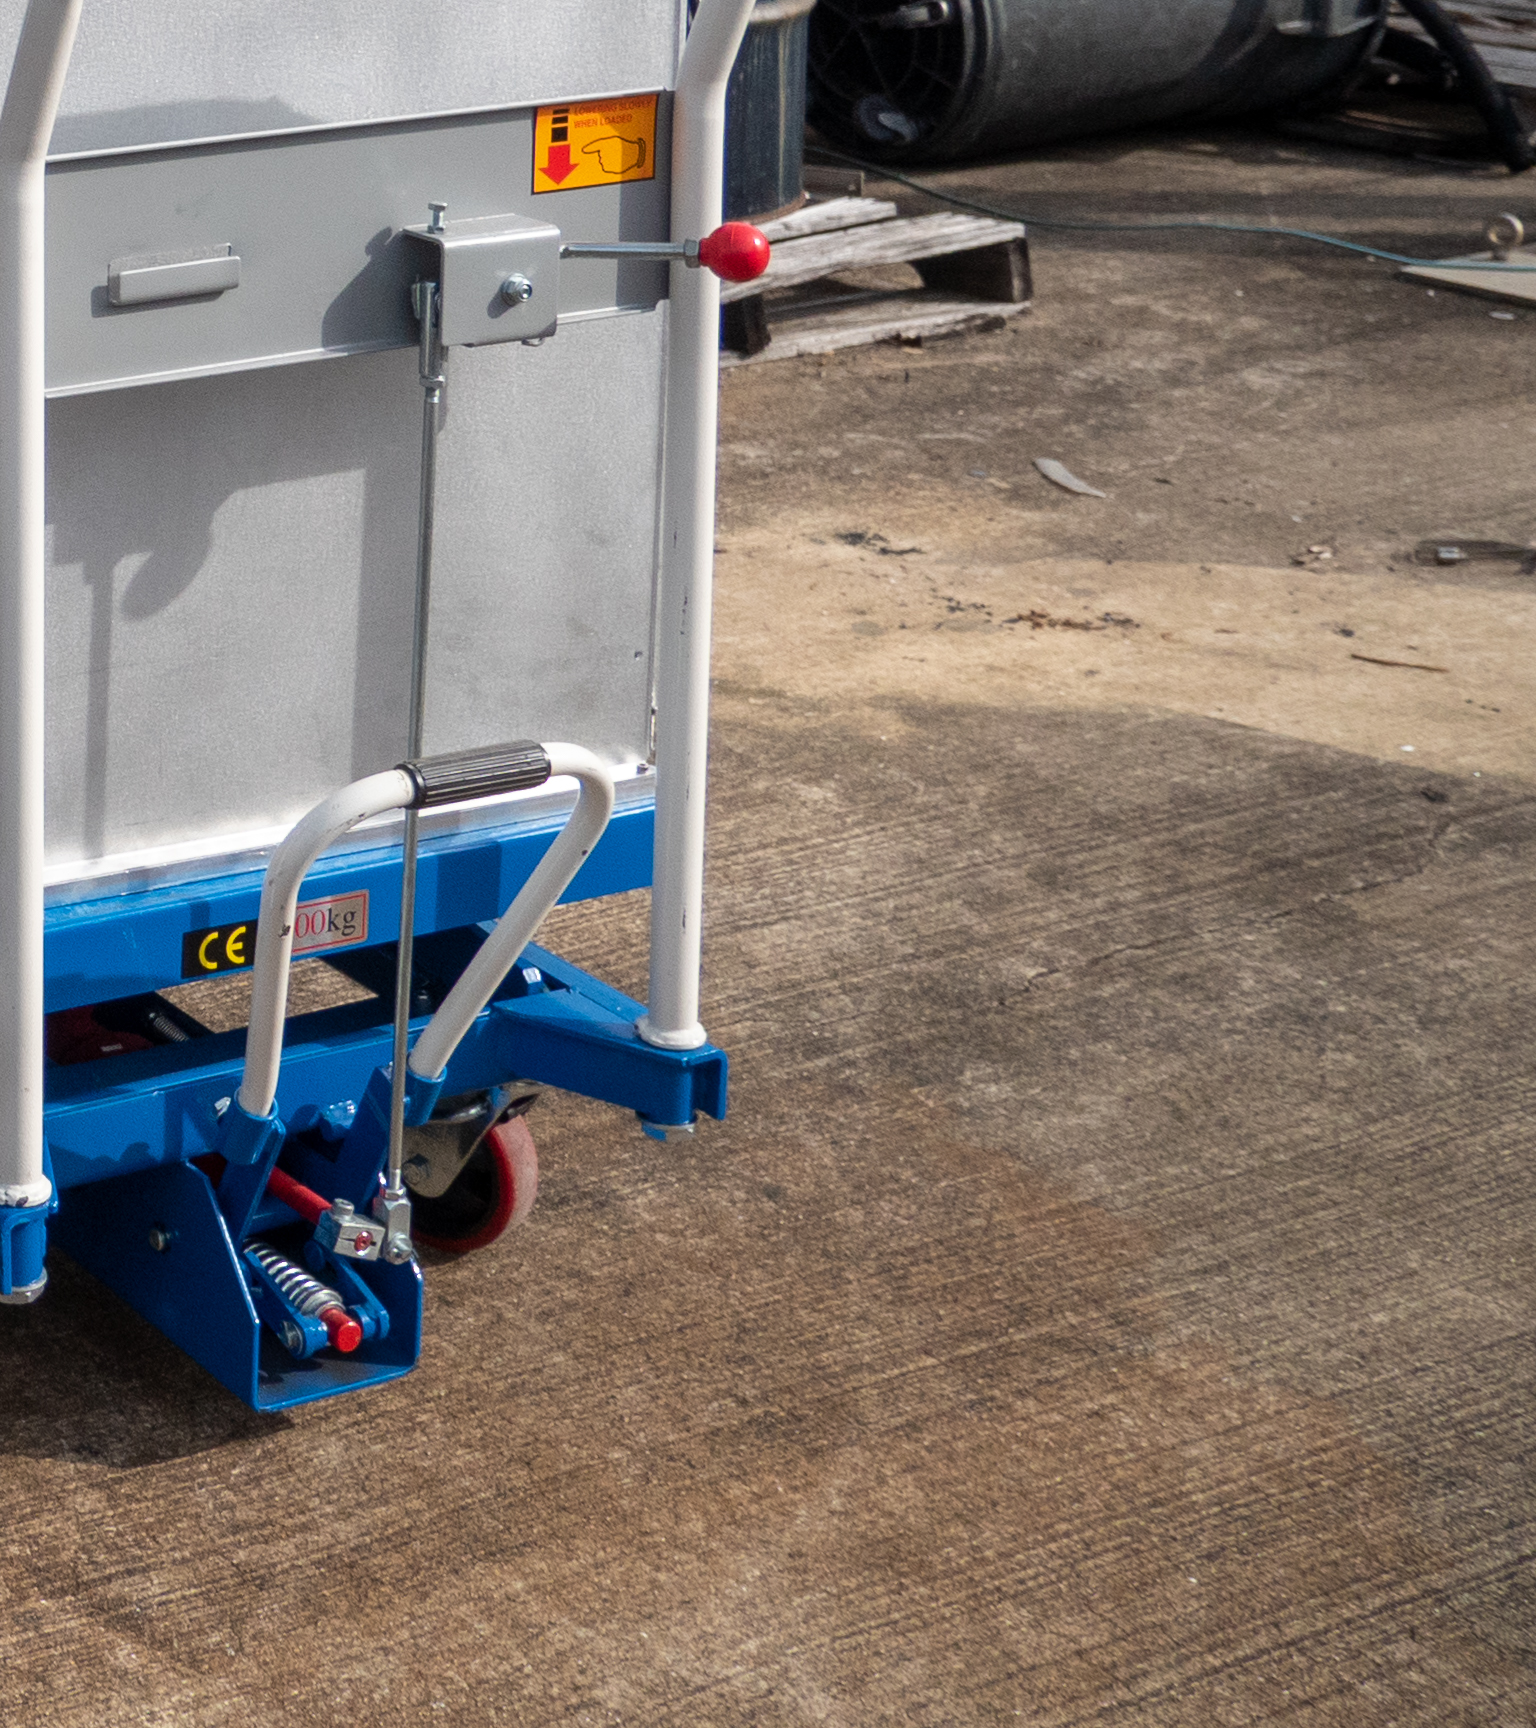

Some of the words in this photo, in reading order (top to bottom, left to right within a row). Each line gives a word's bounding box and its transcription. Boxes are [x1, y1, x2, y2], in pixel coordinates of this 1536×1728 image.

[573, 102, 618, 116] LOWERING
[573, 119, 598, 129] WHEN
[599, 114, 633, 126] LOADED
[294, 907, 357, 939] 00kg
[198, 925, 247, 970] CE
